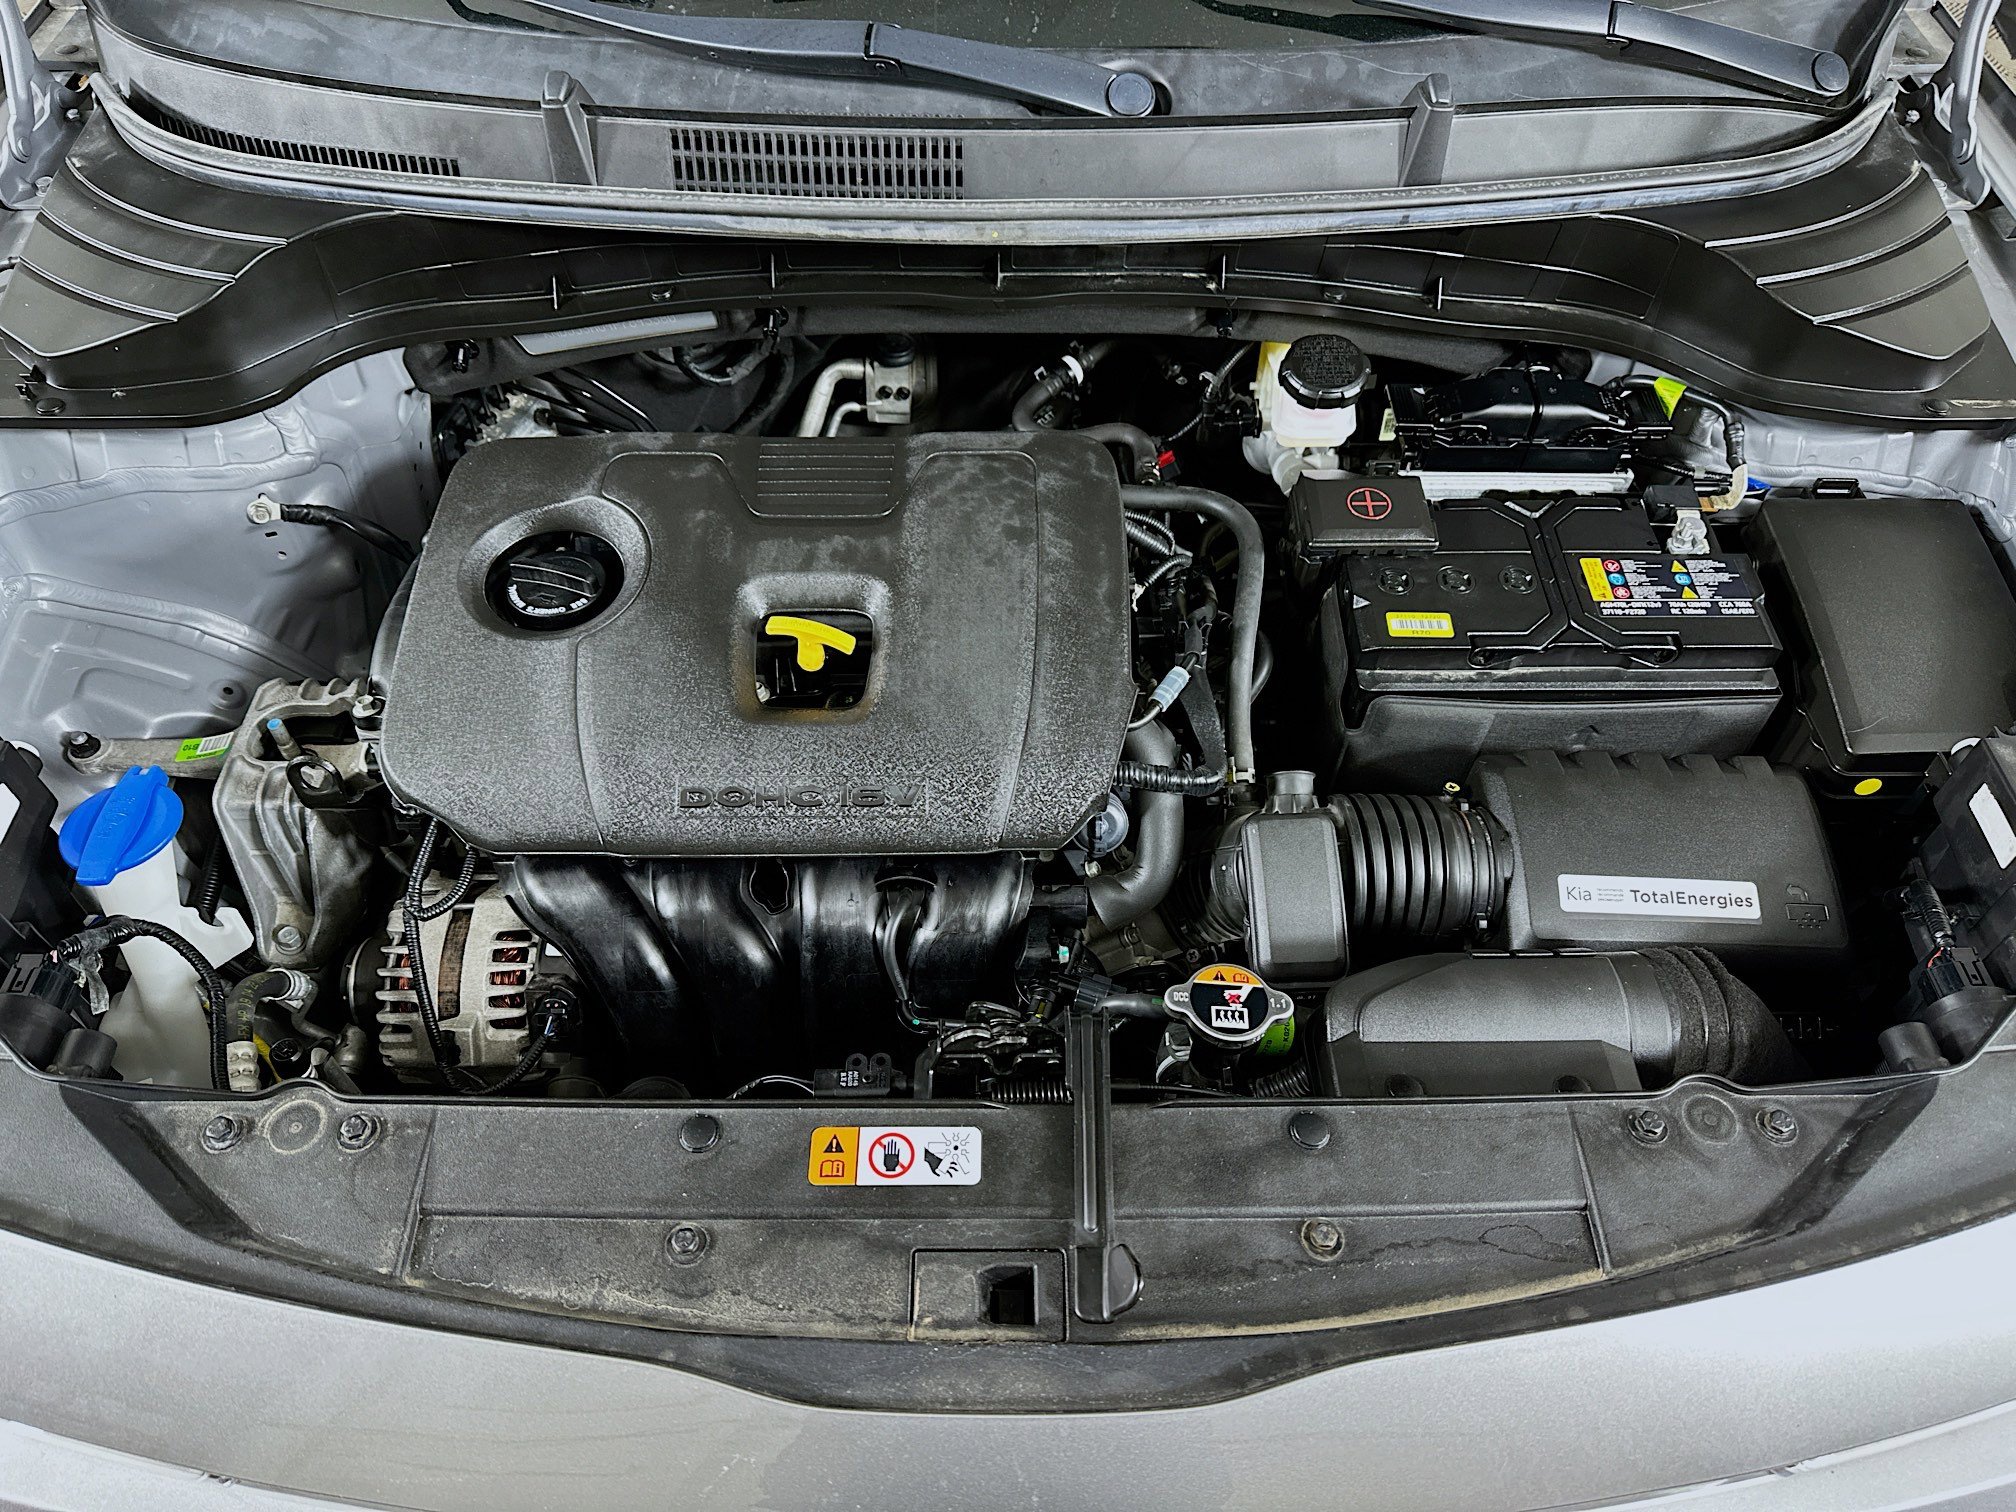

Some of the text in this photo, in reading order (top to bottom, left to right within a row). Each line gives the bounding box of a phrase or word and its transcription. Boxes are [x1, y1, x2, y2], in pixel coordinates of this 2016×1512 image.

[679, 784, 923, 809] DOHC 16V
[1566, 886, 1754, 909] Kia TotalEnergies
[1173, 991, 1189, 1002] DCC
[1269, 997, 1287, 1009] 1.1
